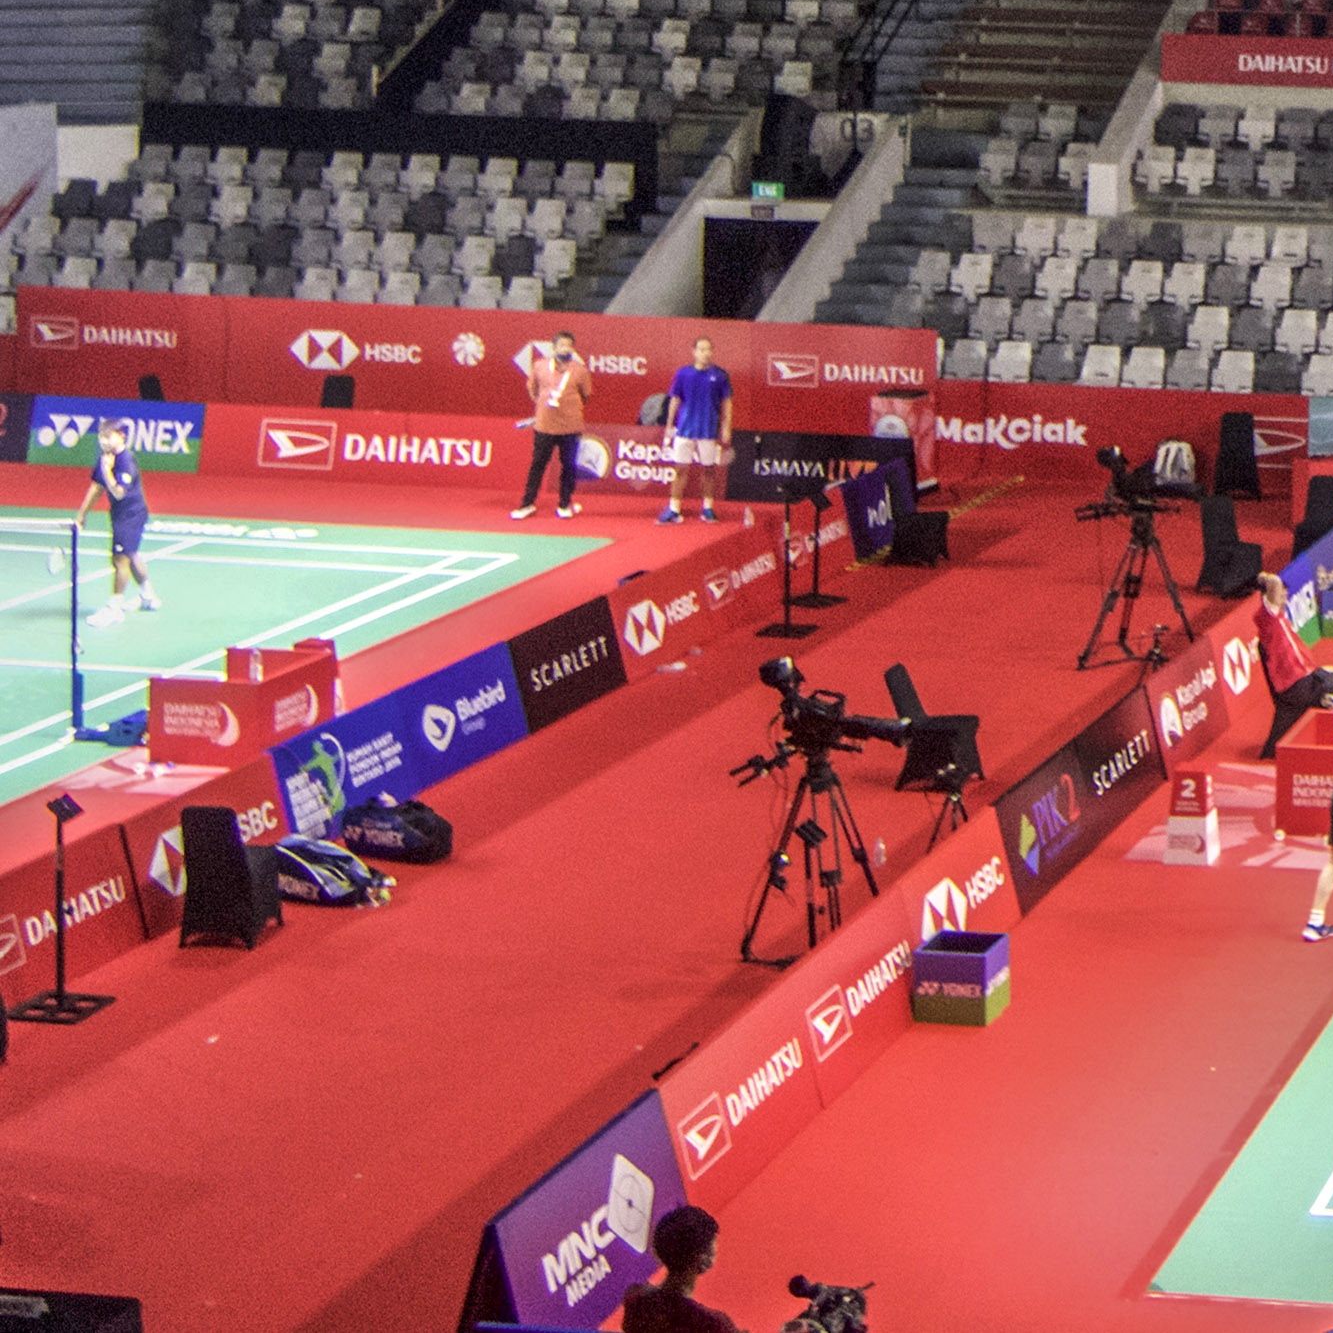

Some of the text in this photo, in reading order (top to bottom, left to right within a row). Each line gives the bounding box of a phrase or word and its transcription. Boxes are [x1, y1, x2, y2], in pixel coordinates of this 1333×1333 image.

[1238, 53, 1329, 75] DAIHATSU
[83, 324, 177, 349] DAIHATSU
[364, 342, 422, 364] HSBC
[589, 354, 647, 376] HSBC
[824, 363, 924, 386] DAIHATSU
[99, 415, 195, 455] ONEX
[343, 432, 493, 466] DAIHATSU
[614, 460, 677, 485] Group
[754, 458, 825, 477] ISMAYA
[665, 592, 700, 624] HSBC
[530, 636, 608, 692] SCARLETT
[455, 679, 507, 722] Bluebird
[1092, 729, 1151, 797] SCARLETT
[1180, 778, 1197, 799] 2
[237, 801, 279, 844] SBC
[965, 856, 1005, 910] HSBC
[24, 876, 126, 946] DAHATSU
[846, 940, 912, 1017] DAIHATSU
[725, 1037, 803, 1127] DAIHATSU
[541, 1206, 616, 1295] MNC
[565, 1254, 612, 1308] MEDIA
